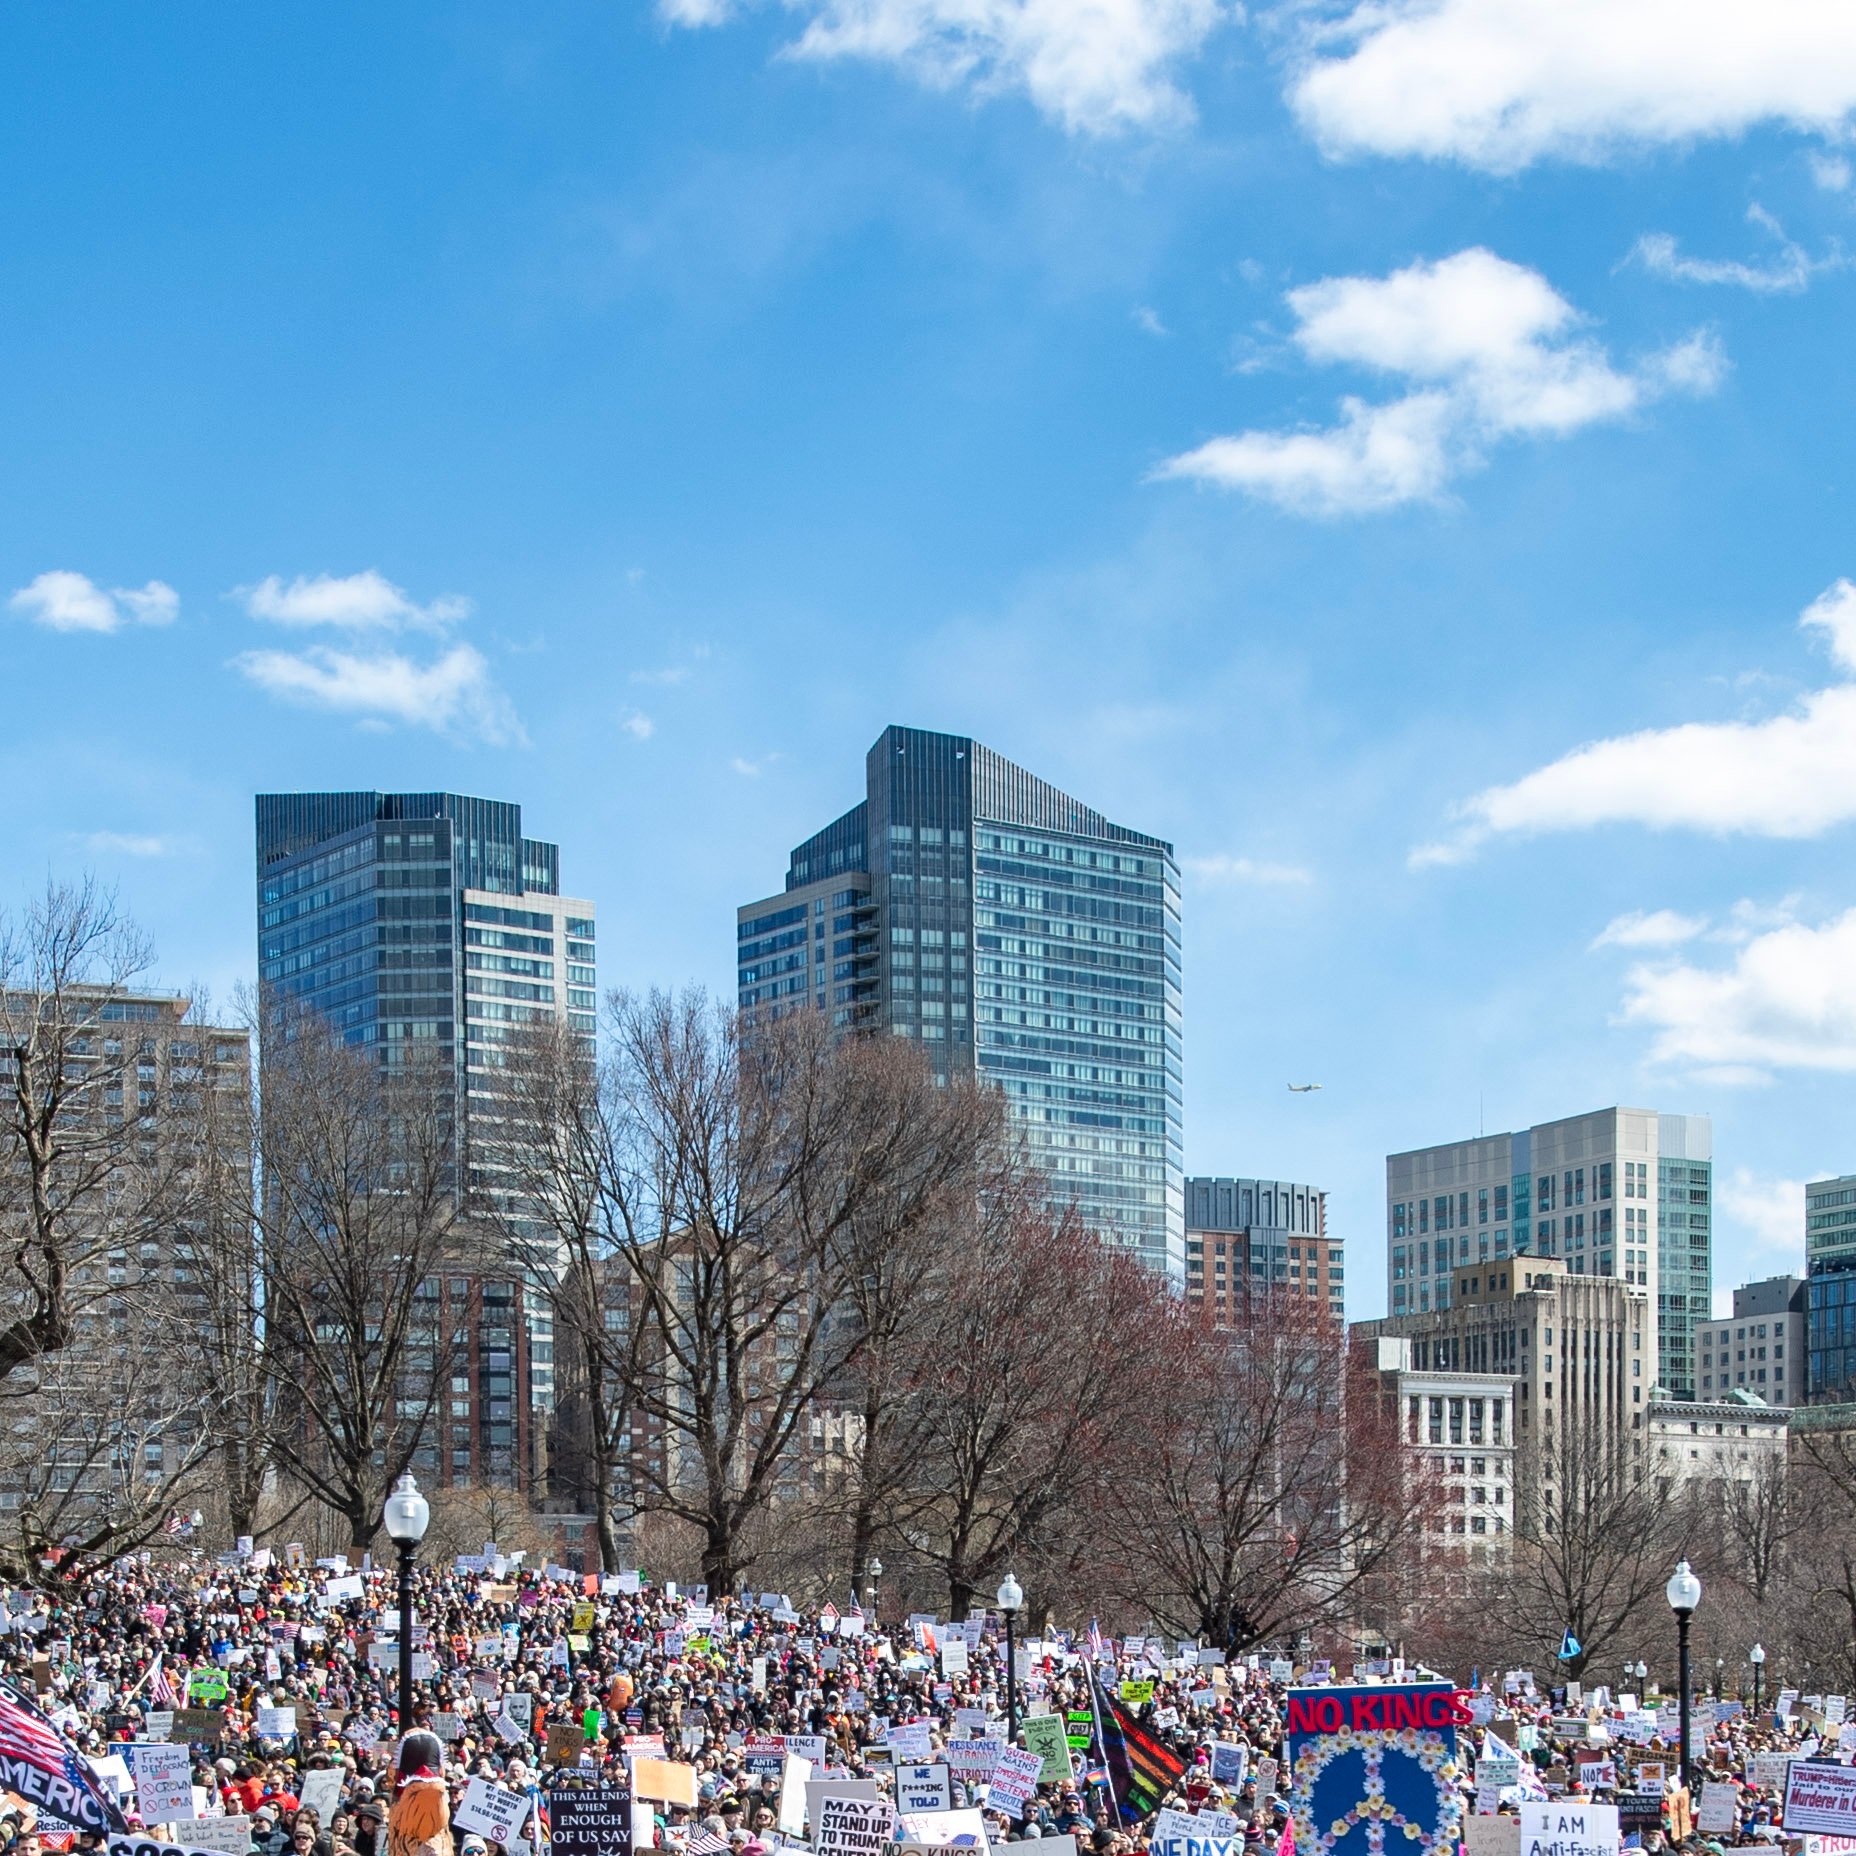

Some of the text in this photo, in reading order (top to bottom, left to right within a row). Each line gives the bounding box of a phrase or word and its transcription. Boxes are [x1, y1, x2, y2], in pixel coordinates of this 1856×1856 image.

[1290, 1690, 1474, 1733] NO KINGS
[1005, 1747, 1038, 1763] GUARD
[552, 1791, 630, 1801] THIS ALL ENDS
[909, 1797, 939, 1807] TOLD
[1789, 1788, 1838, 1809] Murderer
[1839, 1793, 1849, 1810] in
[560, 1815, 622, 1826] ENOUGH
[822, 1814, 891, 1834] STAND UP
[1542, 1816, 1584, 1835] I AM
[552, 1830, 630, 1843] OF US SAY
[821, 1830, 837, 1844] TO
